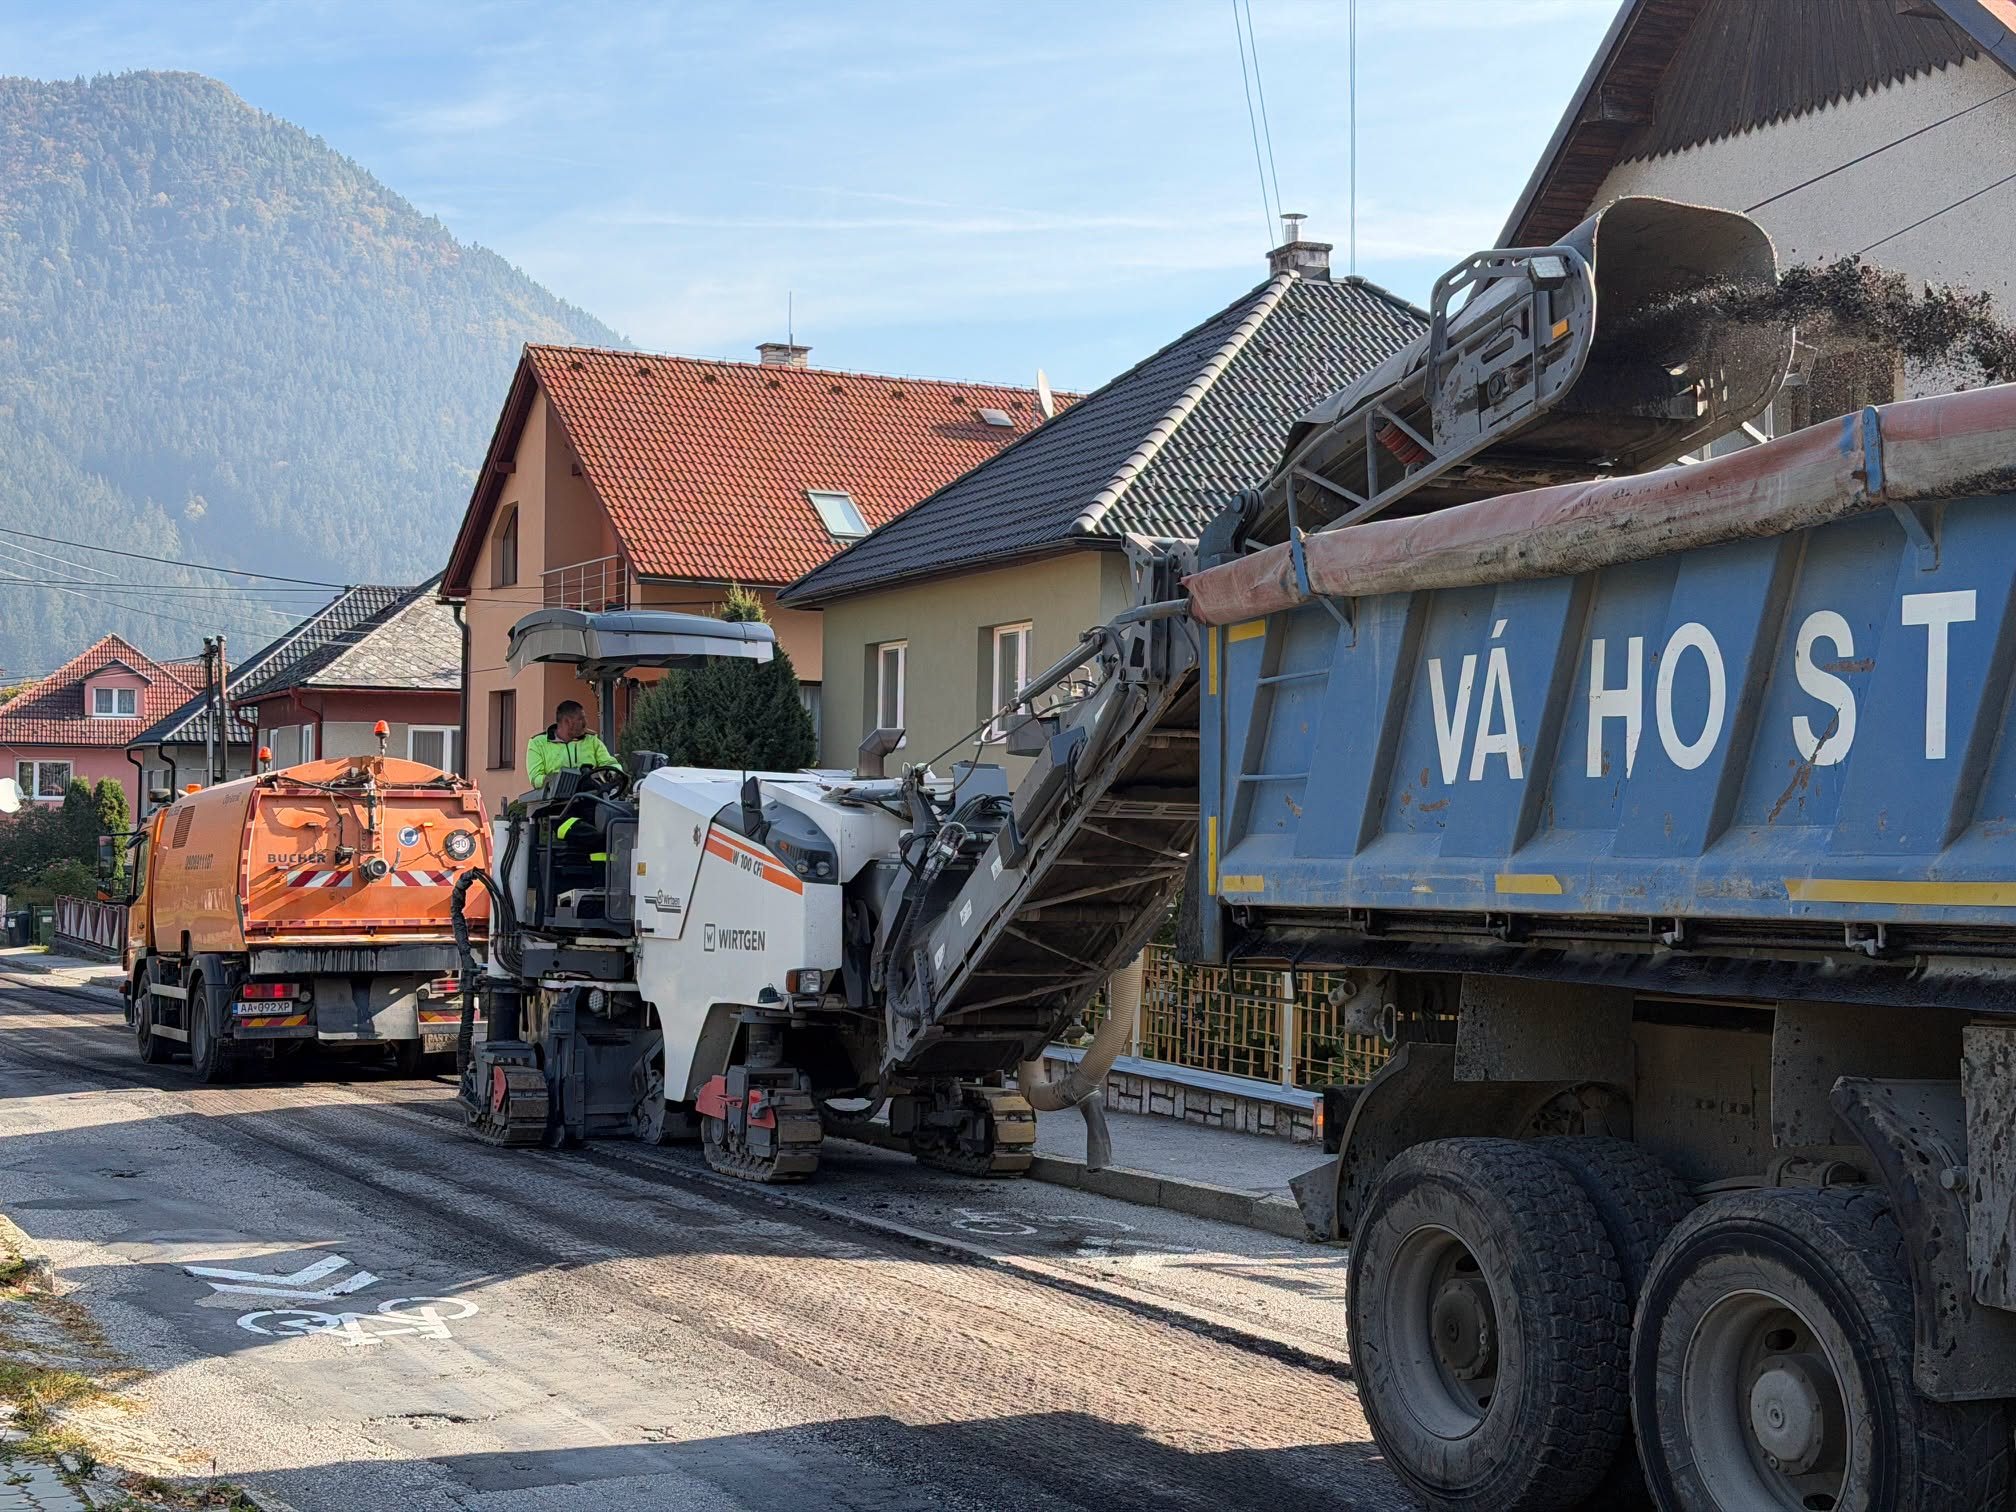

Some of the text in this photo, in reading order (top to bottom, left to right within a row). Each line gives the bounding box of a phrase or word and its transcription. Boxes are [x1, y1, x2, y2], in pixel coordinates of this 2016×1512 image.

[454, 838, 468, 849] 90
[267, 853, 327, 864] BUCHER
[741, 853, 752, 872] 100
[718, 928, 766, 951] WIRTGEN
